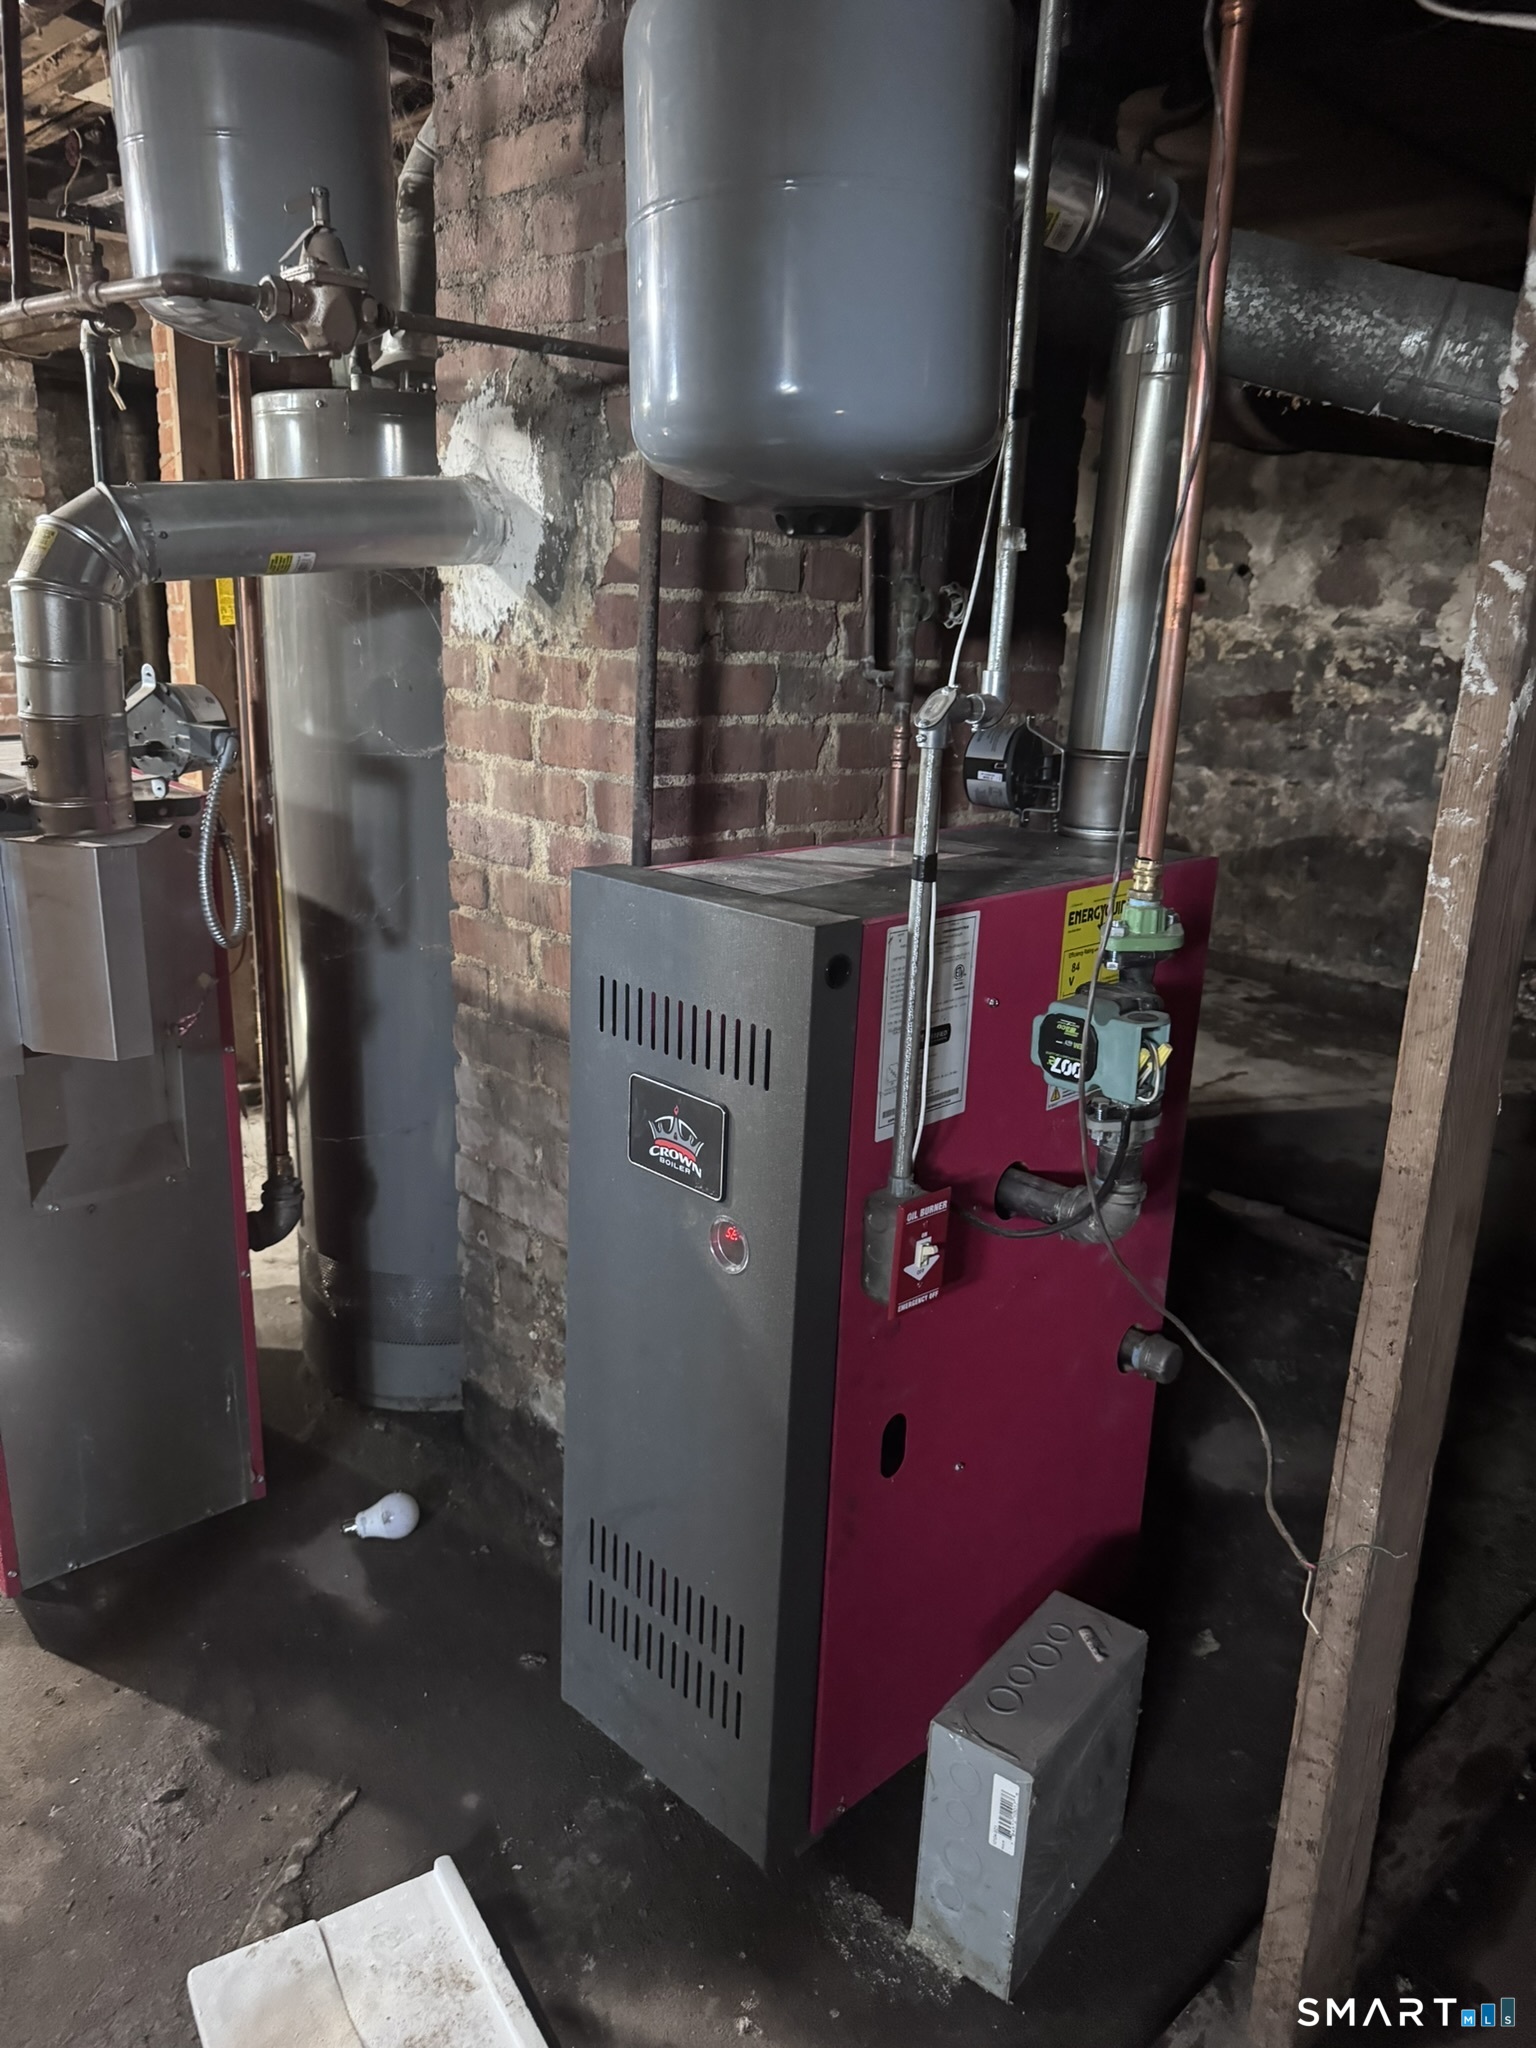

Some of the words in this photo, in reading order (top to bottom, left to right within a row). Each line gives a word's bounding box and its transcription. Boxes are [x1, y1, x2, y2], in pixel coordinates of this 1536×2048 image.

[1071, 962, 1080, 973] 84
[648, 1145, 702, 1179] CROWN
[659, 1157, 691, 1175] BOILER
[906, 1210, 919, 1222] OIL
[920, 1200, 948, 1217] BURNER
[897, 1294, 929, 1313] EMERGENCY
[929, 1290, 939, 1300] OFF
